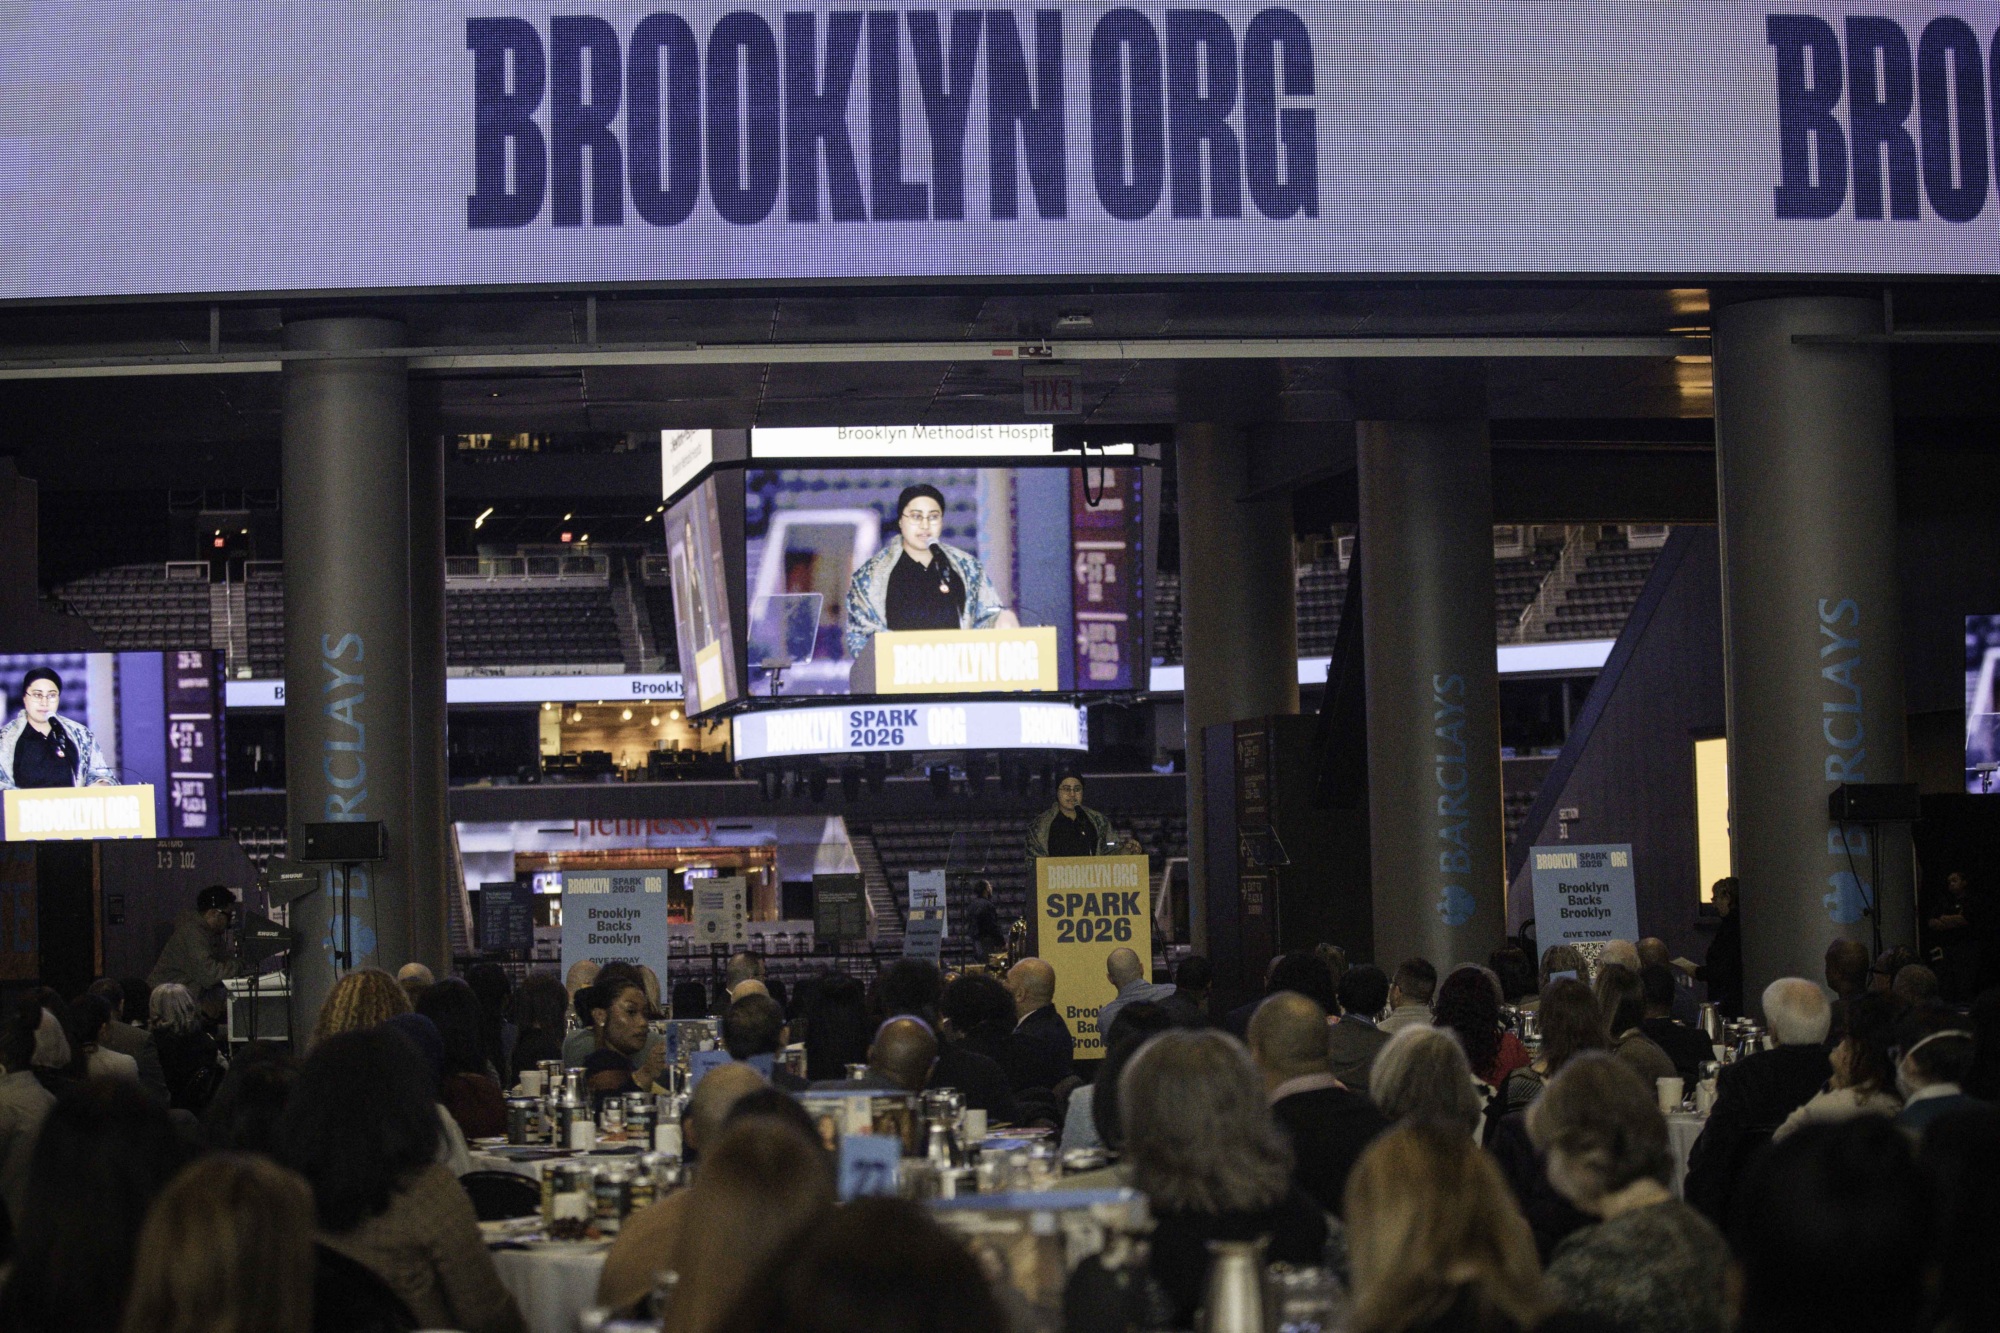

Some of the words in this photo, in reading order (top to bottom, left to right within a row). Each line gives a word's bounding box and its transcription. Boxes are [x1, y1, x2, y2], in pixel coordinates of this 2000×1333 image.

[466, 9, 1068, 229] BROOKLYN
[1089, 6, 1319, 220] ORG
[1766, 14, 2000, 223] BRO
[838, 426, 907, 444] Brooklyn
[912, 425, 993, 439] Methodist
[1000, 425, 1053, 442] Hospit
[893, 642, 997, 685] BROOKLYN
[632, 680, 685, 697] Brookly
[850, 709, 918, 728] SPARK
[1818, 598, 1869, 856] BRCLAYS
[850, 728, 905, 747] 2026
[322, 633, 368, 898] BRCLAYS
[1433, 674, 1472, 874] BARCLAYS
[180, 851, 196, 869] 102
[1536, 853, 1577, 869] BROOKLYN
[1580, 852, 1608, 860] SPARK
[1580, 860, 1603, 868] 2026
[1610, 851, 1628, 867] ORG
[612, 877, 641, 886] SPARK
[1047, 864, 1112, 889] BROOKLYN
[1113, 863, 1138, 887] ORG
[567, 877, 610, 894] BROOKLYN
[612, 885, 636, 894] 2026
[644, 877, 662, 893] ORG
[1558, 882, 1610, 894] Brooklyn
[1046, 891, 1141, 918] SPARK
[1568, 895, 1602, 906] Backs
[588, 908, 641, 920] Brooklyn
[1560, 907, 1611, 919] Brooklyn
[597, 921, 632, 932] Backs
[1056, 917, 1132, 943] 2026
[588, 933, 641, 946] Brooklyn
[1066, 1005, 1102, 1019] Broo
